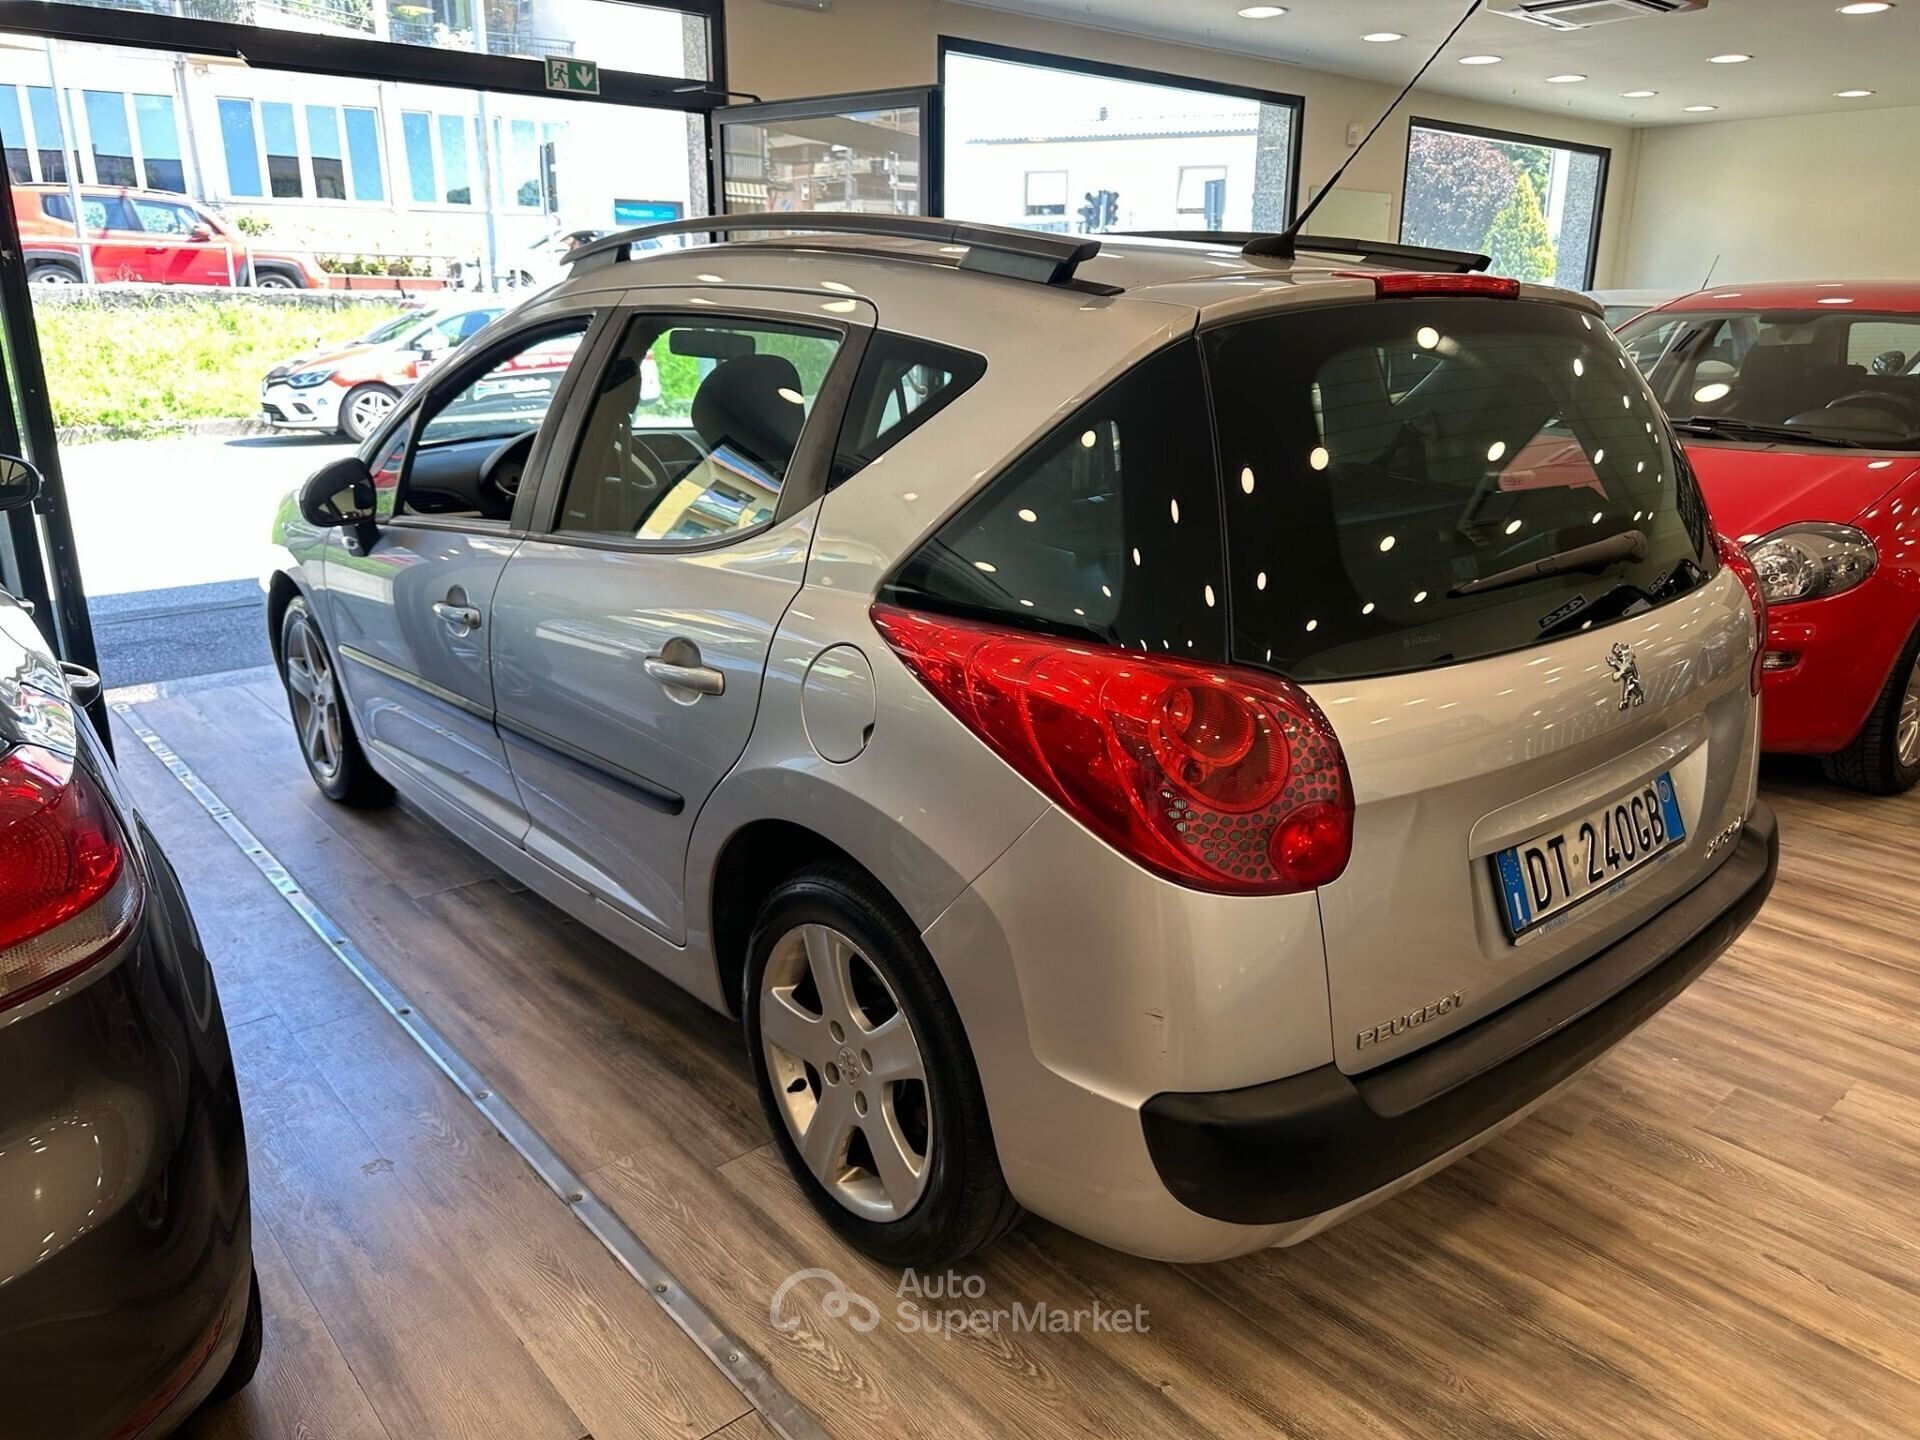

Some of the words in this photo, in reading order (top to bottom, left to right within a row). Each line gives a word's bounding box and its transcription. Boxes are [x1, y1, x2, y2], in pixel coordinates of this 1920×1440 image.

[1524, 834, 1571, 912] DT
[1578, 788, 1665, 884] 240GB
[1355, 986, 1468, 1051] PEUGEOT
